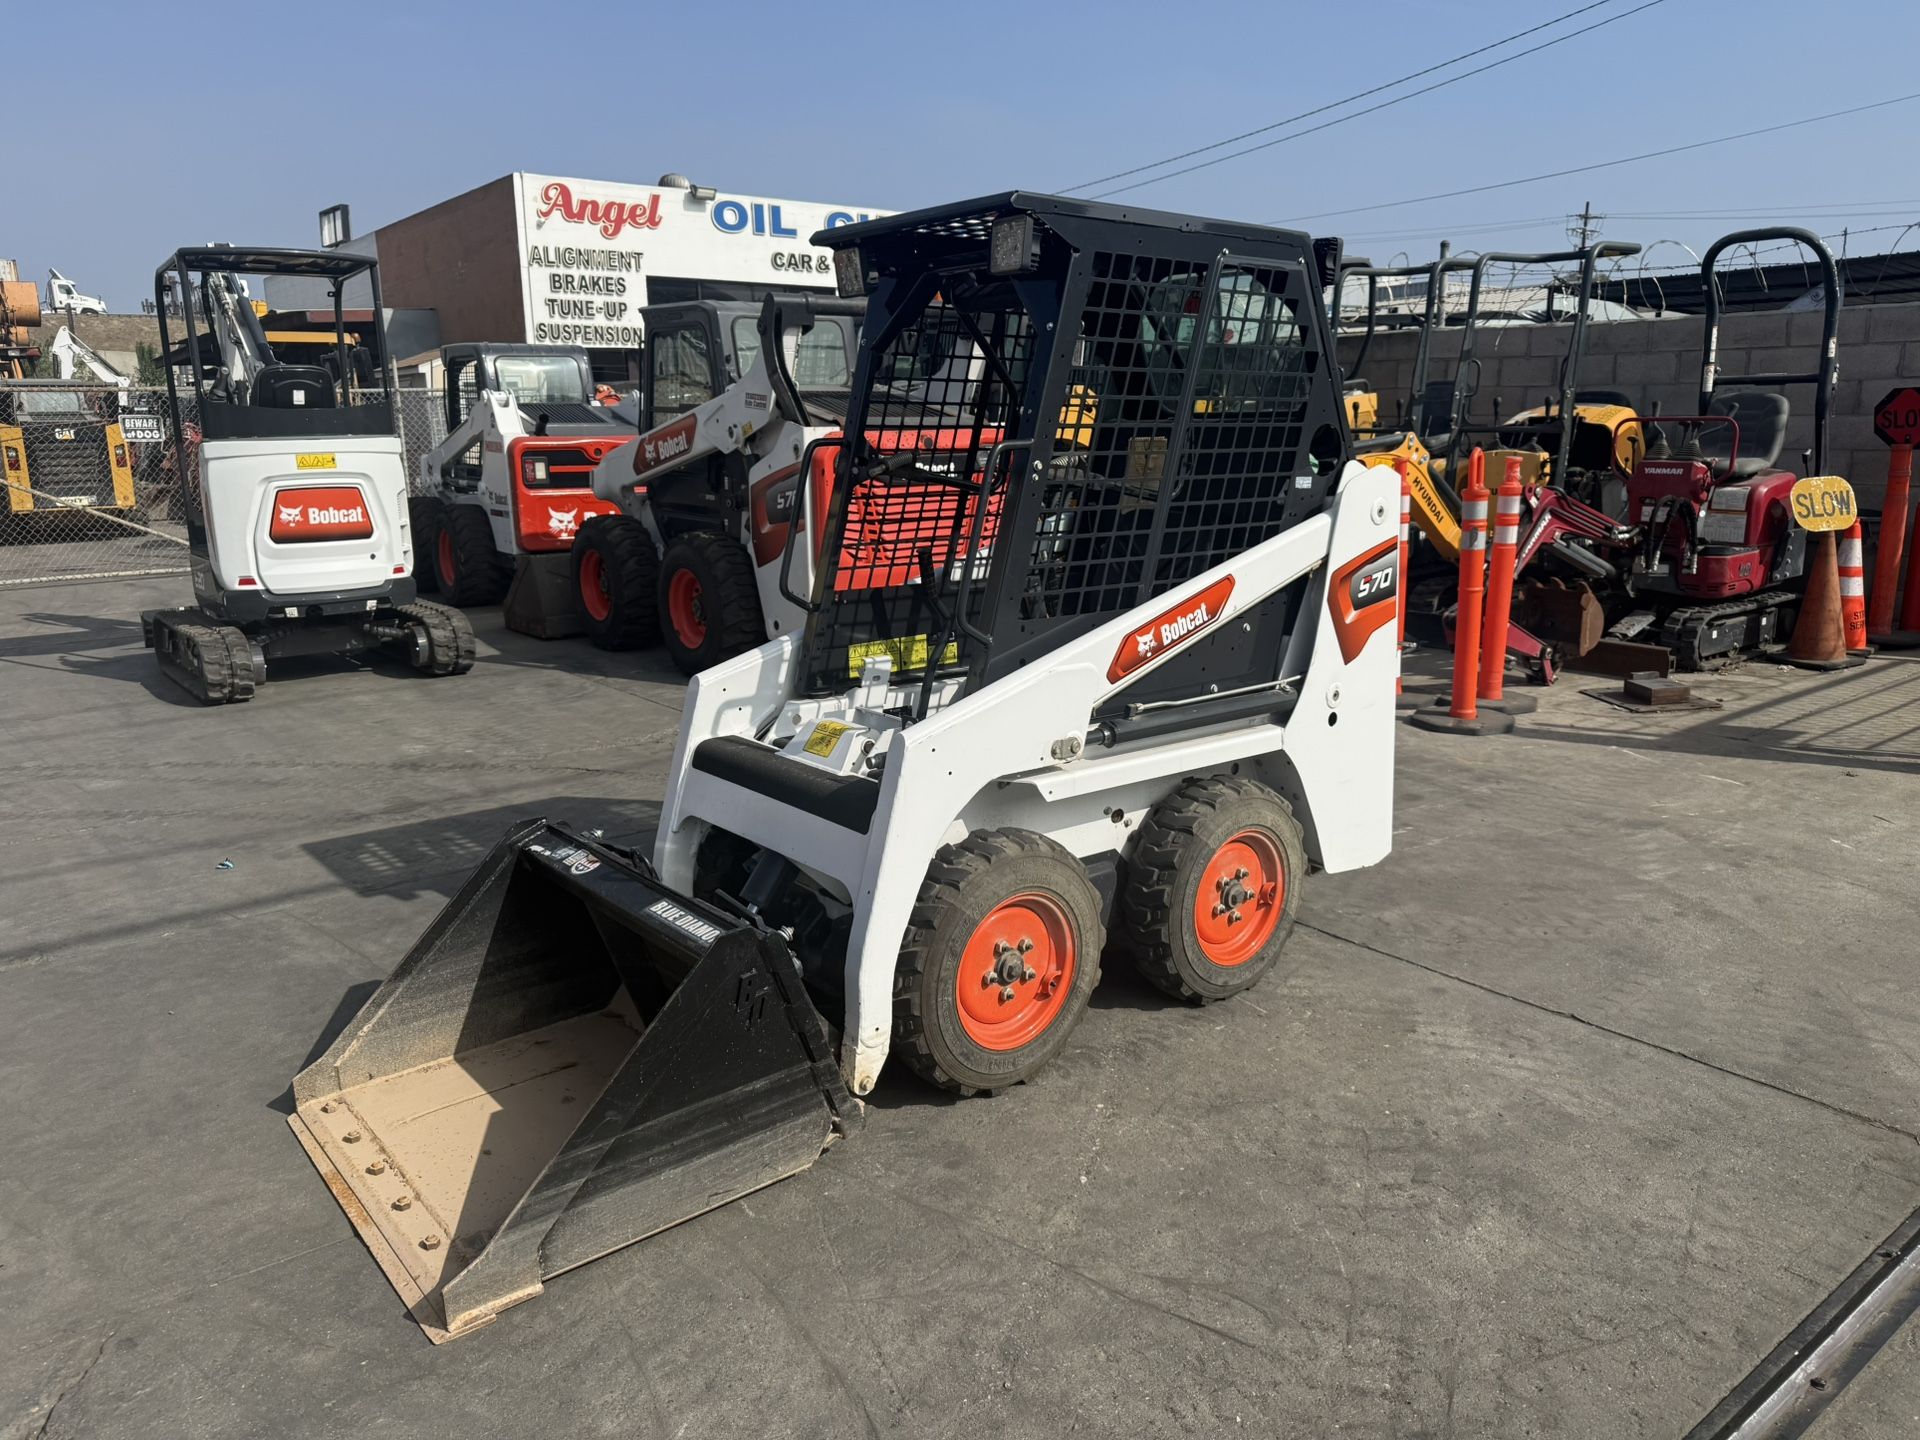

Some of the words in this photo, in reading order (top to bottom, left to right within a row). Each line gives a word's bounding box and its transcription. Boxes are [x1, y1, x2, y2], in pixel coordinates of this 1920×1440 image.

[537, 182, 662, 239] Angel
[711, 200, 798, 239] OIL
[529, 245, 644, 272] ALIGNMENT
[771, 252, 813, 272] CAR
[816, 255, 831, 273] &
[549, 272, 627, 296] BRAKES
[544, 297, 628, 320] TUNE-UP
[536, 322, 642, 346] SUSPENSION
[125, 418, 158, 429] BEWARE
[1881, 408, 1920, 429] SLO
[54, 428, 76, 440] CAT
[136, 430, 160, 439] DOG
[657, 430, 688, 460] Bobcat
[1644, 467, 1684, 475] YANMAR
[1412, 476, 1444, 524] HYUNDAI
[1795, 490, 1851, 519] SLOW
[307, 506, 363, 525] Bobcat
[1357, 567, 1393, 598] S70
[1160, 602, 1209, 646] Bobcat
[649, 900, 685, 922] BLUE
[674, 914, 720, 943] DIAMO
